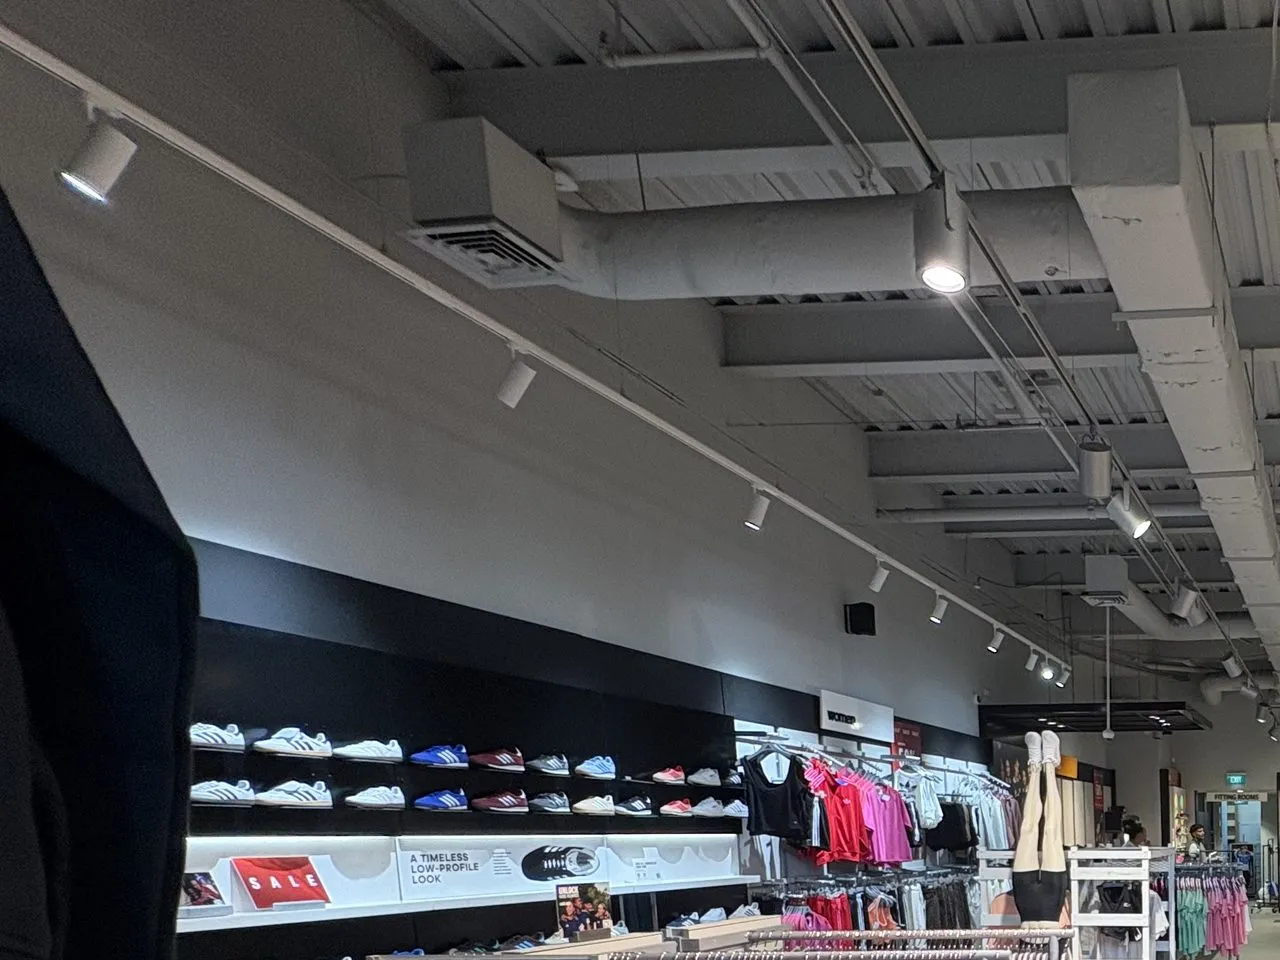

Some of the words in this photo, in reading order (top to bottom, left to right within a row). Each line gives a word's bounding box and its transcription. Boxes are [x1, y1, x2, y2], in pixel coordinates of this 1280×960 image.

[411, 854, 418, 863] A
[420, 853, 469, 863] TIMELESS
[411, 862, 479, 874] LOW-PROFILE
[249, 873, 319, 890] SALE
[412, 874, 442, 884] LOOK
